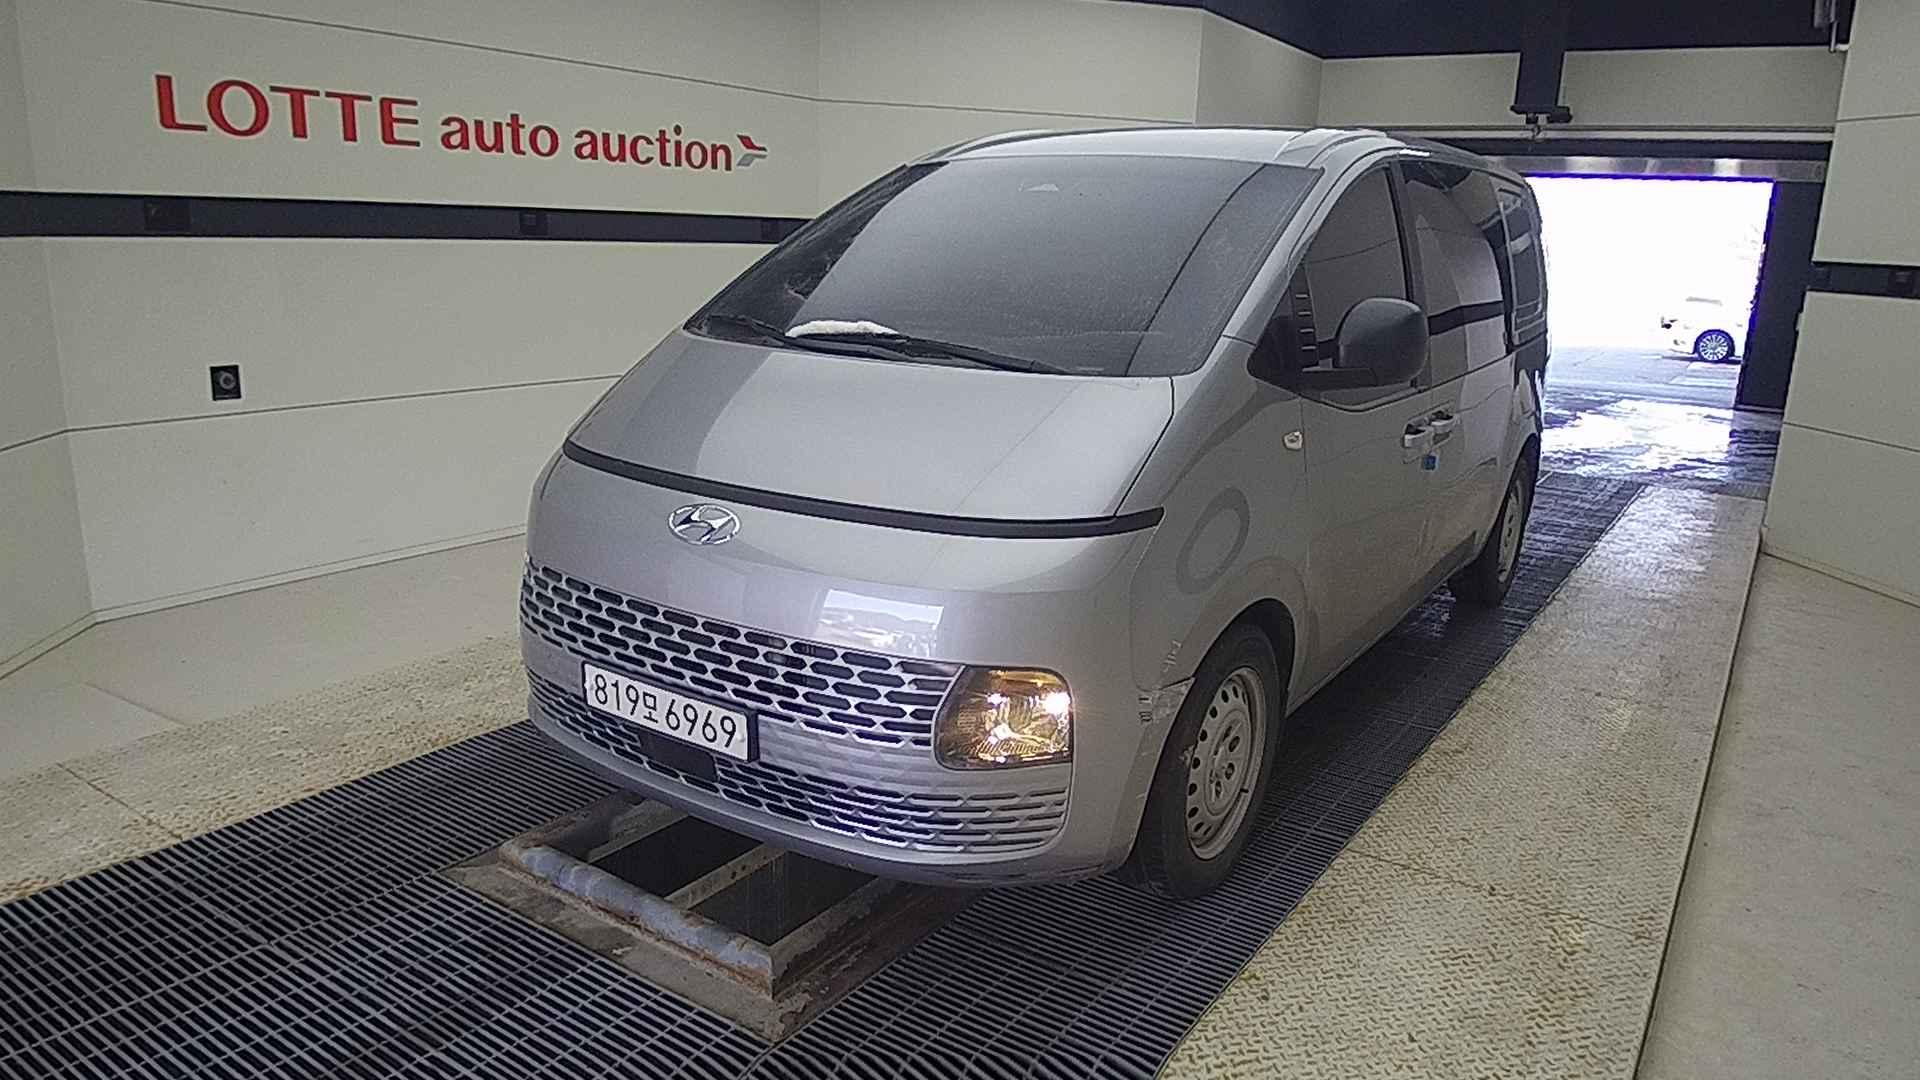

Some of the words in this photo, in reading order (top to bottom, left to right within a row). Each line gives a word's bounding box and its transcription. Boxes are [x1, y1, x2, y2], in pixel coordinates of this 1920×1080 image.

[154, 73, 420, 147] LOTTE
[440, 113, 560, 158] auto
[573, 124, 732, 172] auction
[594, 674, 737, 748] 819모6969
